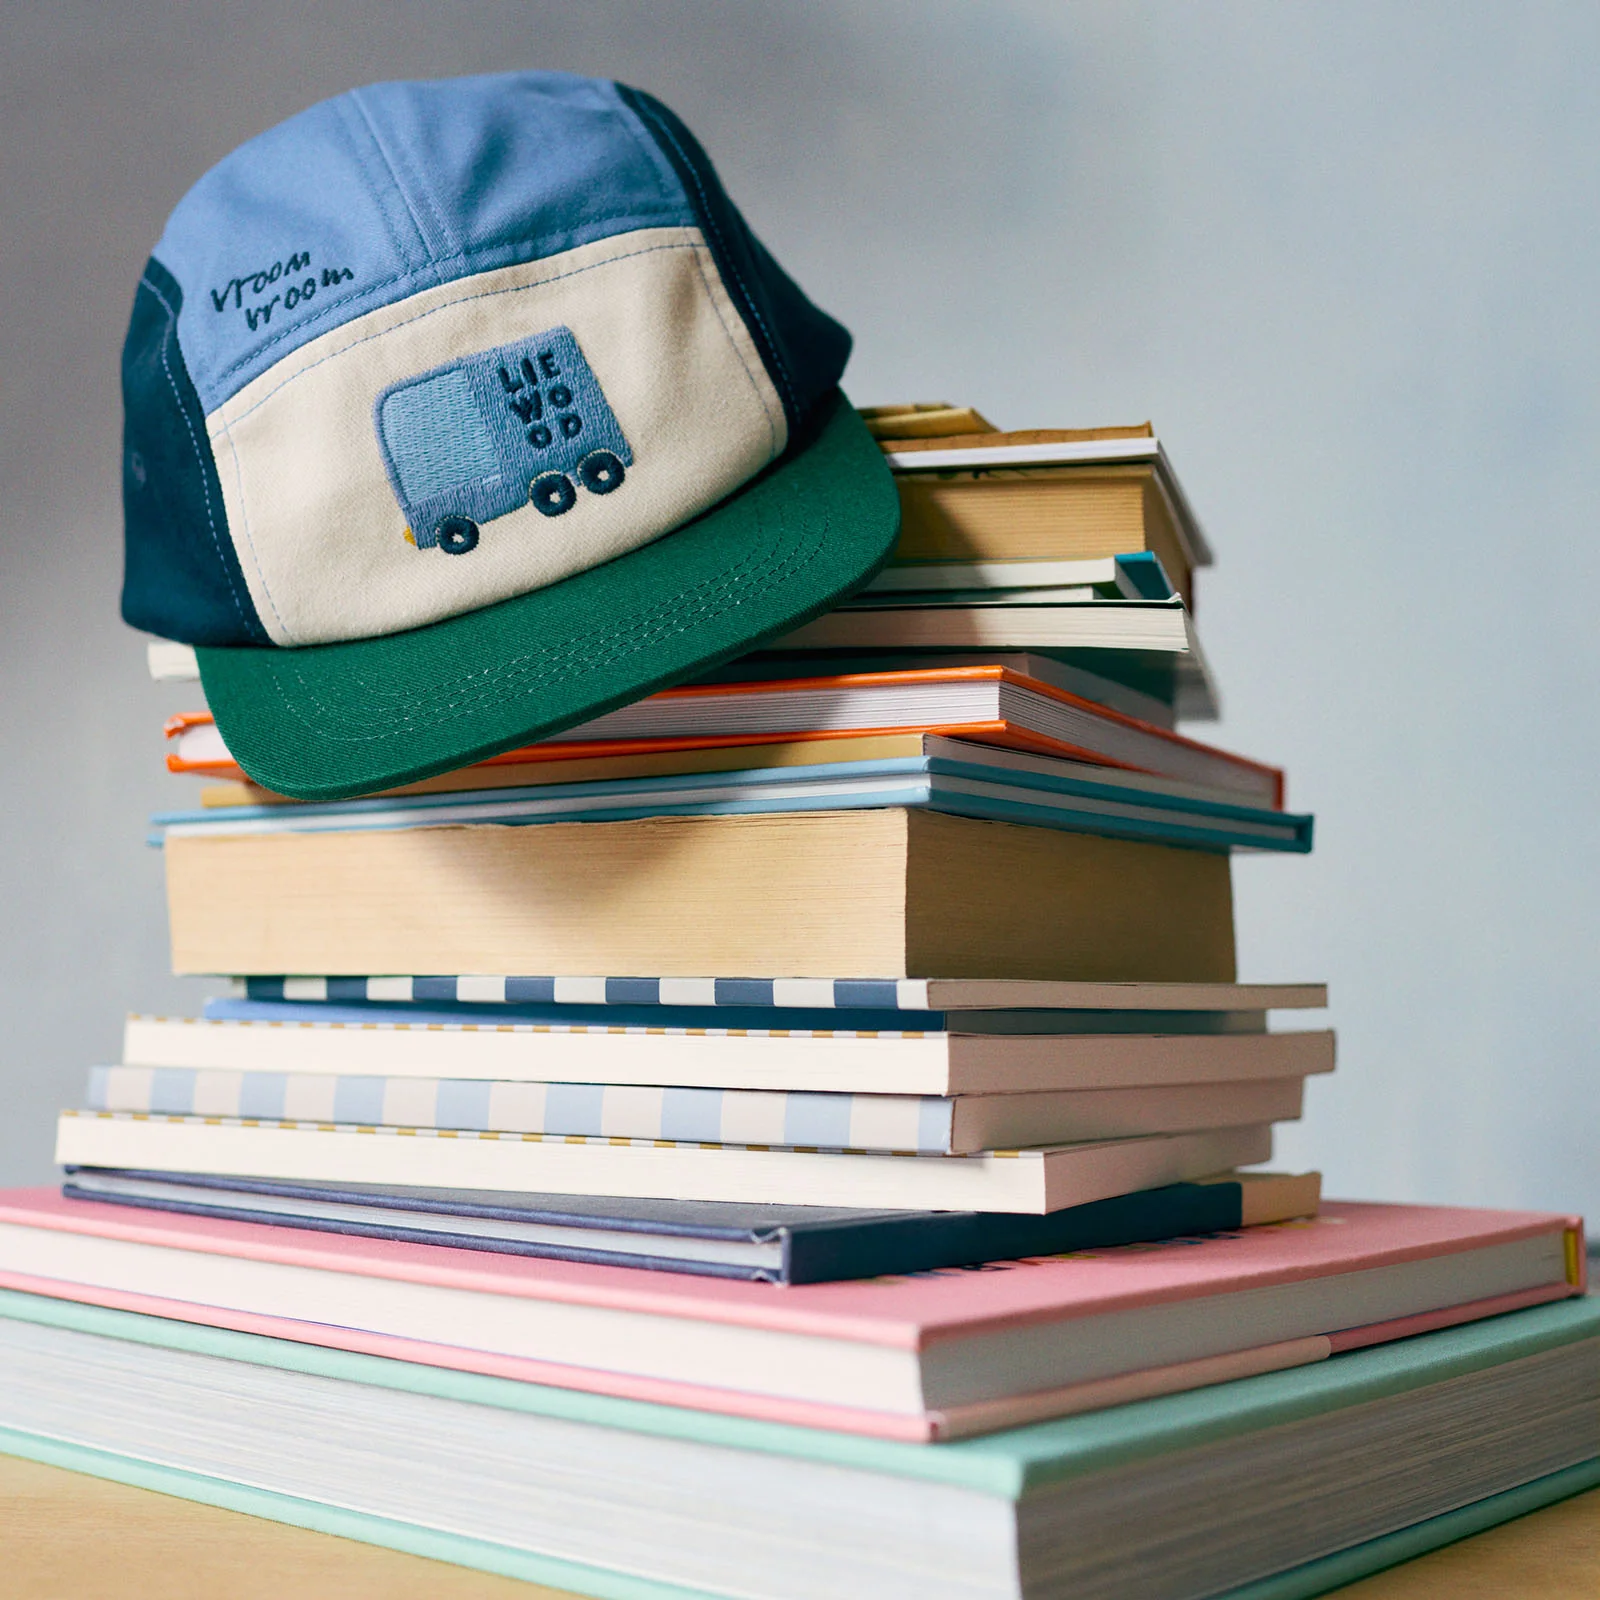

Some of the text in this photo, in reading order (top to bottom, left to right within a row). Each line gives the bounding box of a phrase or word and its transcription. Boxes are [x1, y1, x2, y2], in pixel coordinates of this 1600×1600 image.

[210, 251, 311, 313] vroom
[245, 267, 355, 331] vroom
[497, 349, 561, 394] LIE
[508, 383, 573, 425] WO
[527, 412, 583, 450] OD
